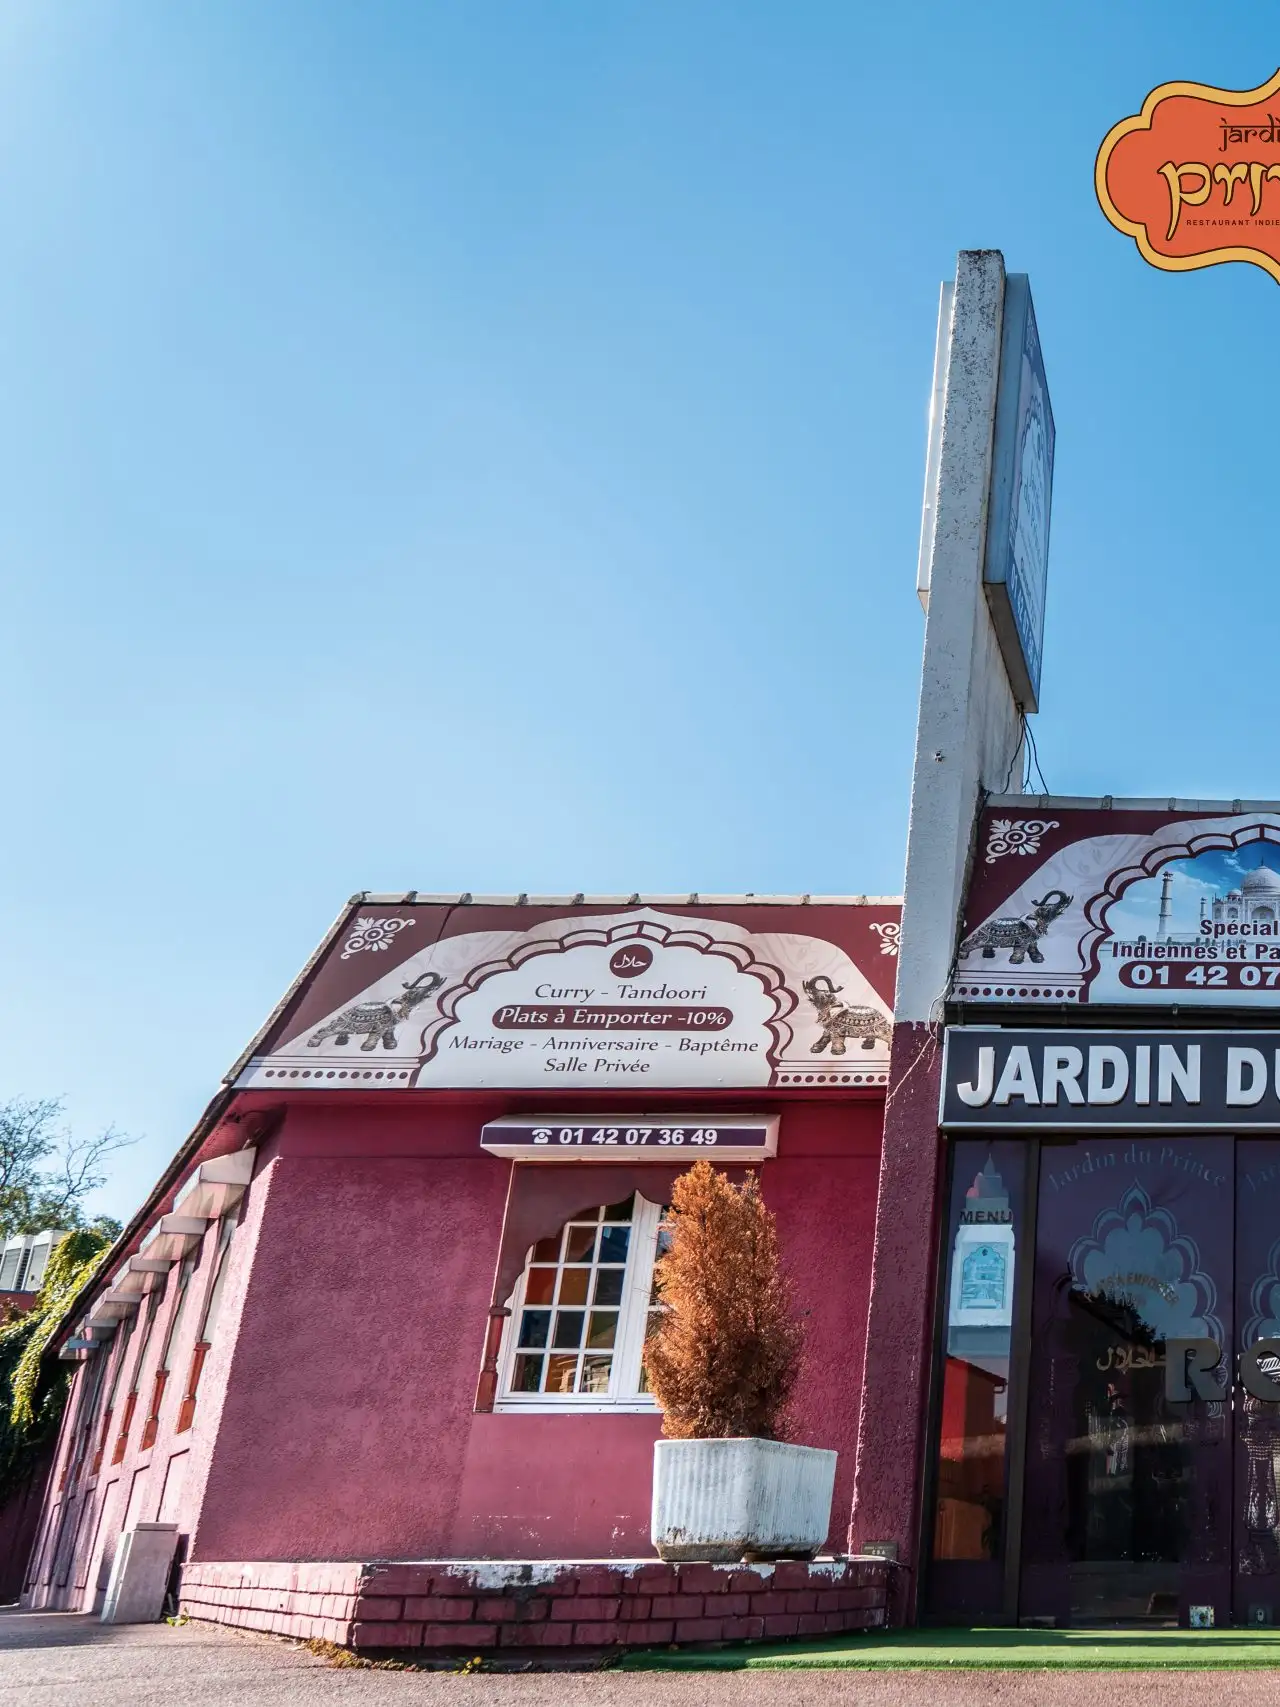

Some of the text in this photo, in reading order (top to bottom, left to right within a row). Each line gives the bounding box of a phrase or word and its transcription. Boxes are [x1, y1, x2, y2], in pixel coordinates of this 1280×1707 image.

[1112, 941, 1218, 960] Indiennes
[1226, 943, 1246, 959] et
[613, 954, 647, 971] حلال
[1130, 964, 1169, 985] 01
[1185, 964, 1228, 985] 42
[535, 984, 595, 1003] Curry
[617, 984, 707, 1000] Tandoori
[499, 1008, 727, 1028] Plats à Emporter -10%
[448, 1035, 524, 1054] Mariage
[542, 1037, 659, 1051] Anniversaire
[678, 1037, 758, 1056] Baptême
[544, 1057, 650, 1072] Salle Privée
[957, 1043, 1201, 1107] JARDIN
[559, 1128, 718, 1145] 01 42 07 36 49
[1049, 1144, 1226, 1192] Jardin du Prince
[960, 1210, 1012, 1224] MENU
